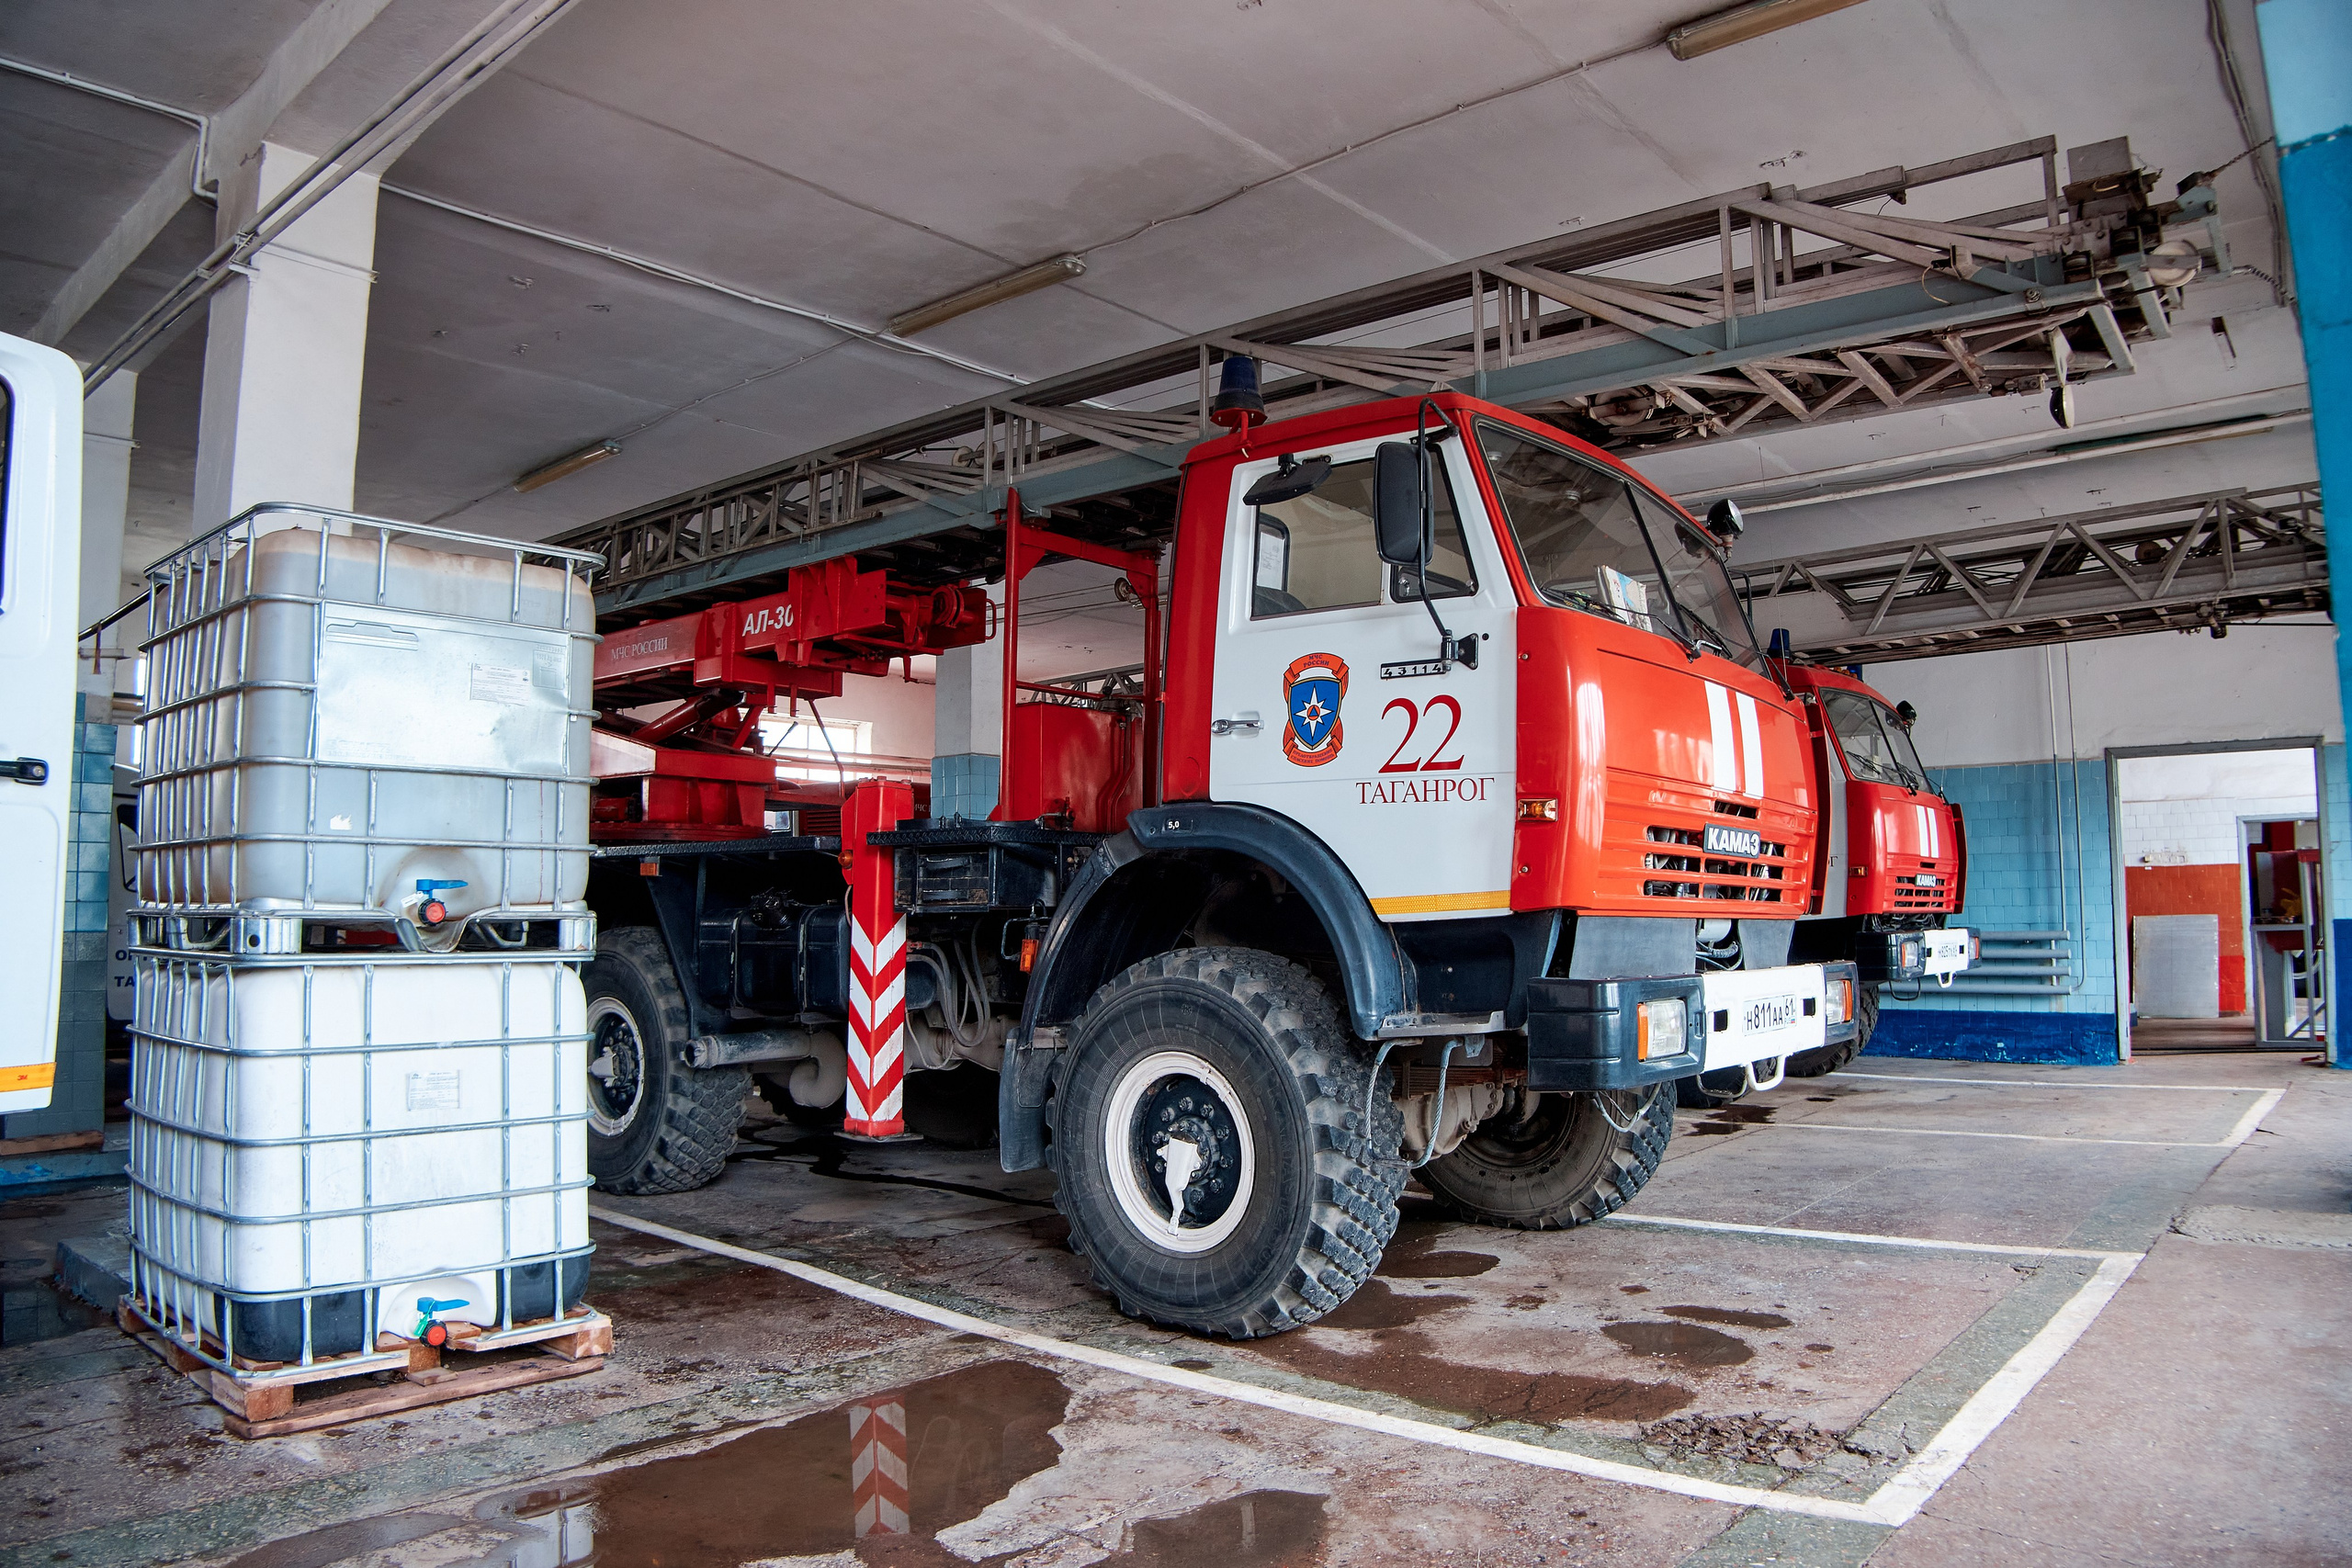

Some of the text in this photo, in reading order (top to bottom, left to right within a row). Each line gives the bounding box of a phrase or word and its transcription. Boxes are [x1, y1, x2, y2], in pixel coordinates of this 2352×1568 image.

[741, 604, 794, 637] АЛ-30
[611, 637, 668, 660] МЧС РОССИИ
[1384, 664, 1442, 677] 43114
[1378, 694, 1464, 773] 22
[1355, 777, 1495, 804] ТАГАНРОГ
[1708, 827, 1759, 856] КАМАЗ
[1917, 874, 1937, 887] КАМАЗ
